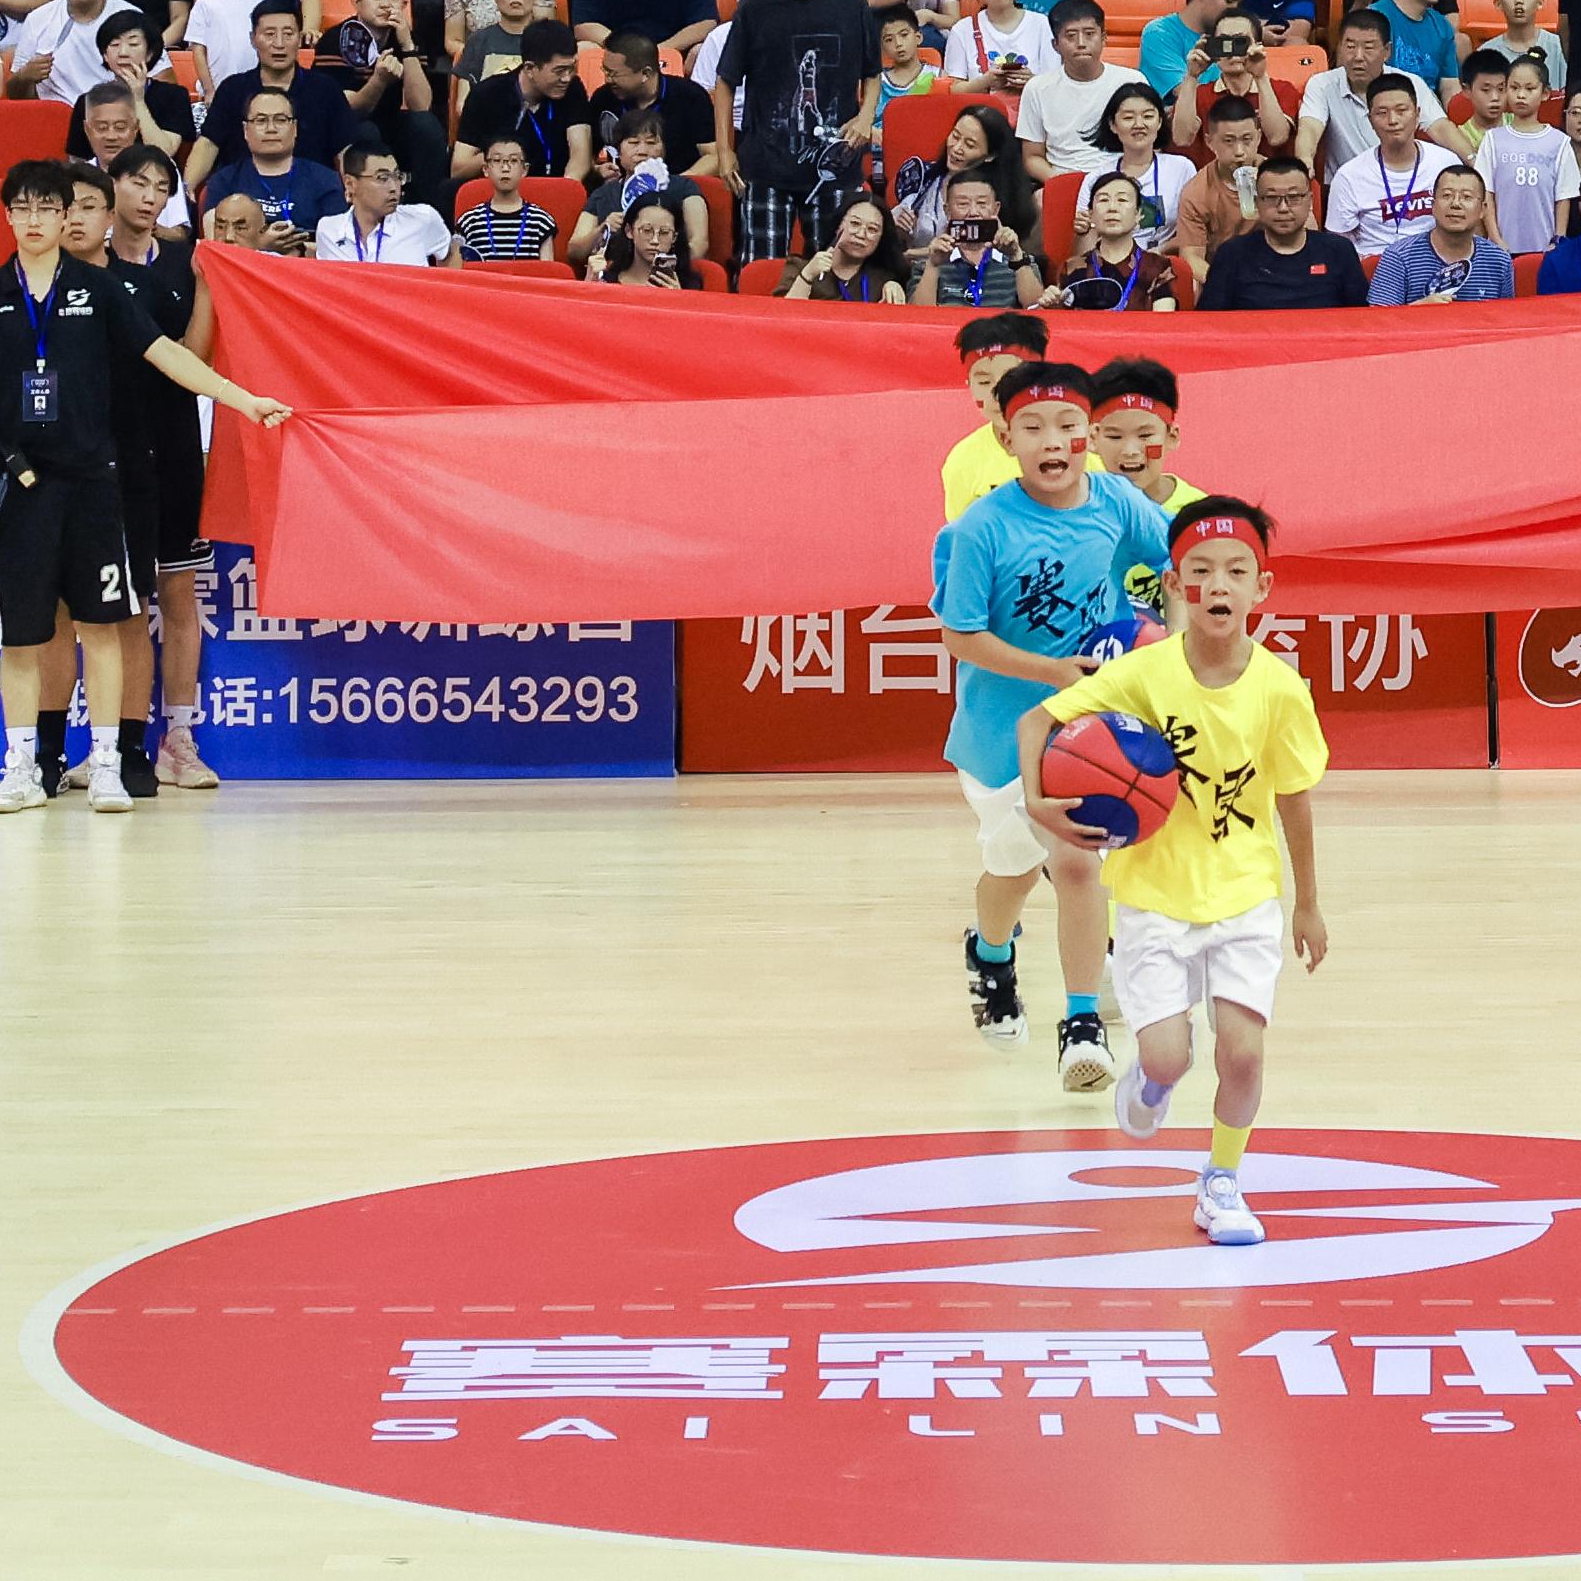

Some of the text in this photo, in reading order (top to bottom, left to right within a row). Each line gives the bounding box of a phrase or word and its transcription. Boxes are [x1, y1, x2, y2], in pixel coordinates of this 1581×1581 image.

[1514, 165, 1538, 187] 88
[1195, 518, 1232, 537] 中国
[99, 564, 124, 603] 2
[372, 1417, 708, 1441] SAI
[909, 1413, 1221, 1436] LIN
